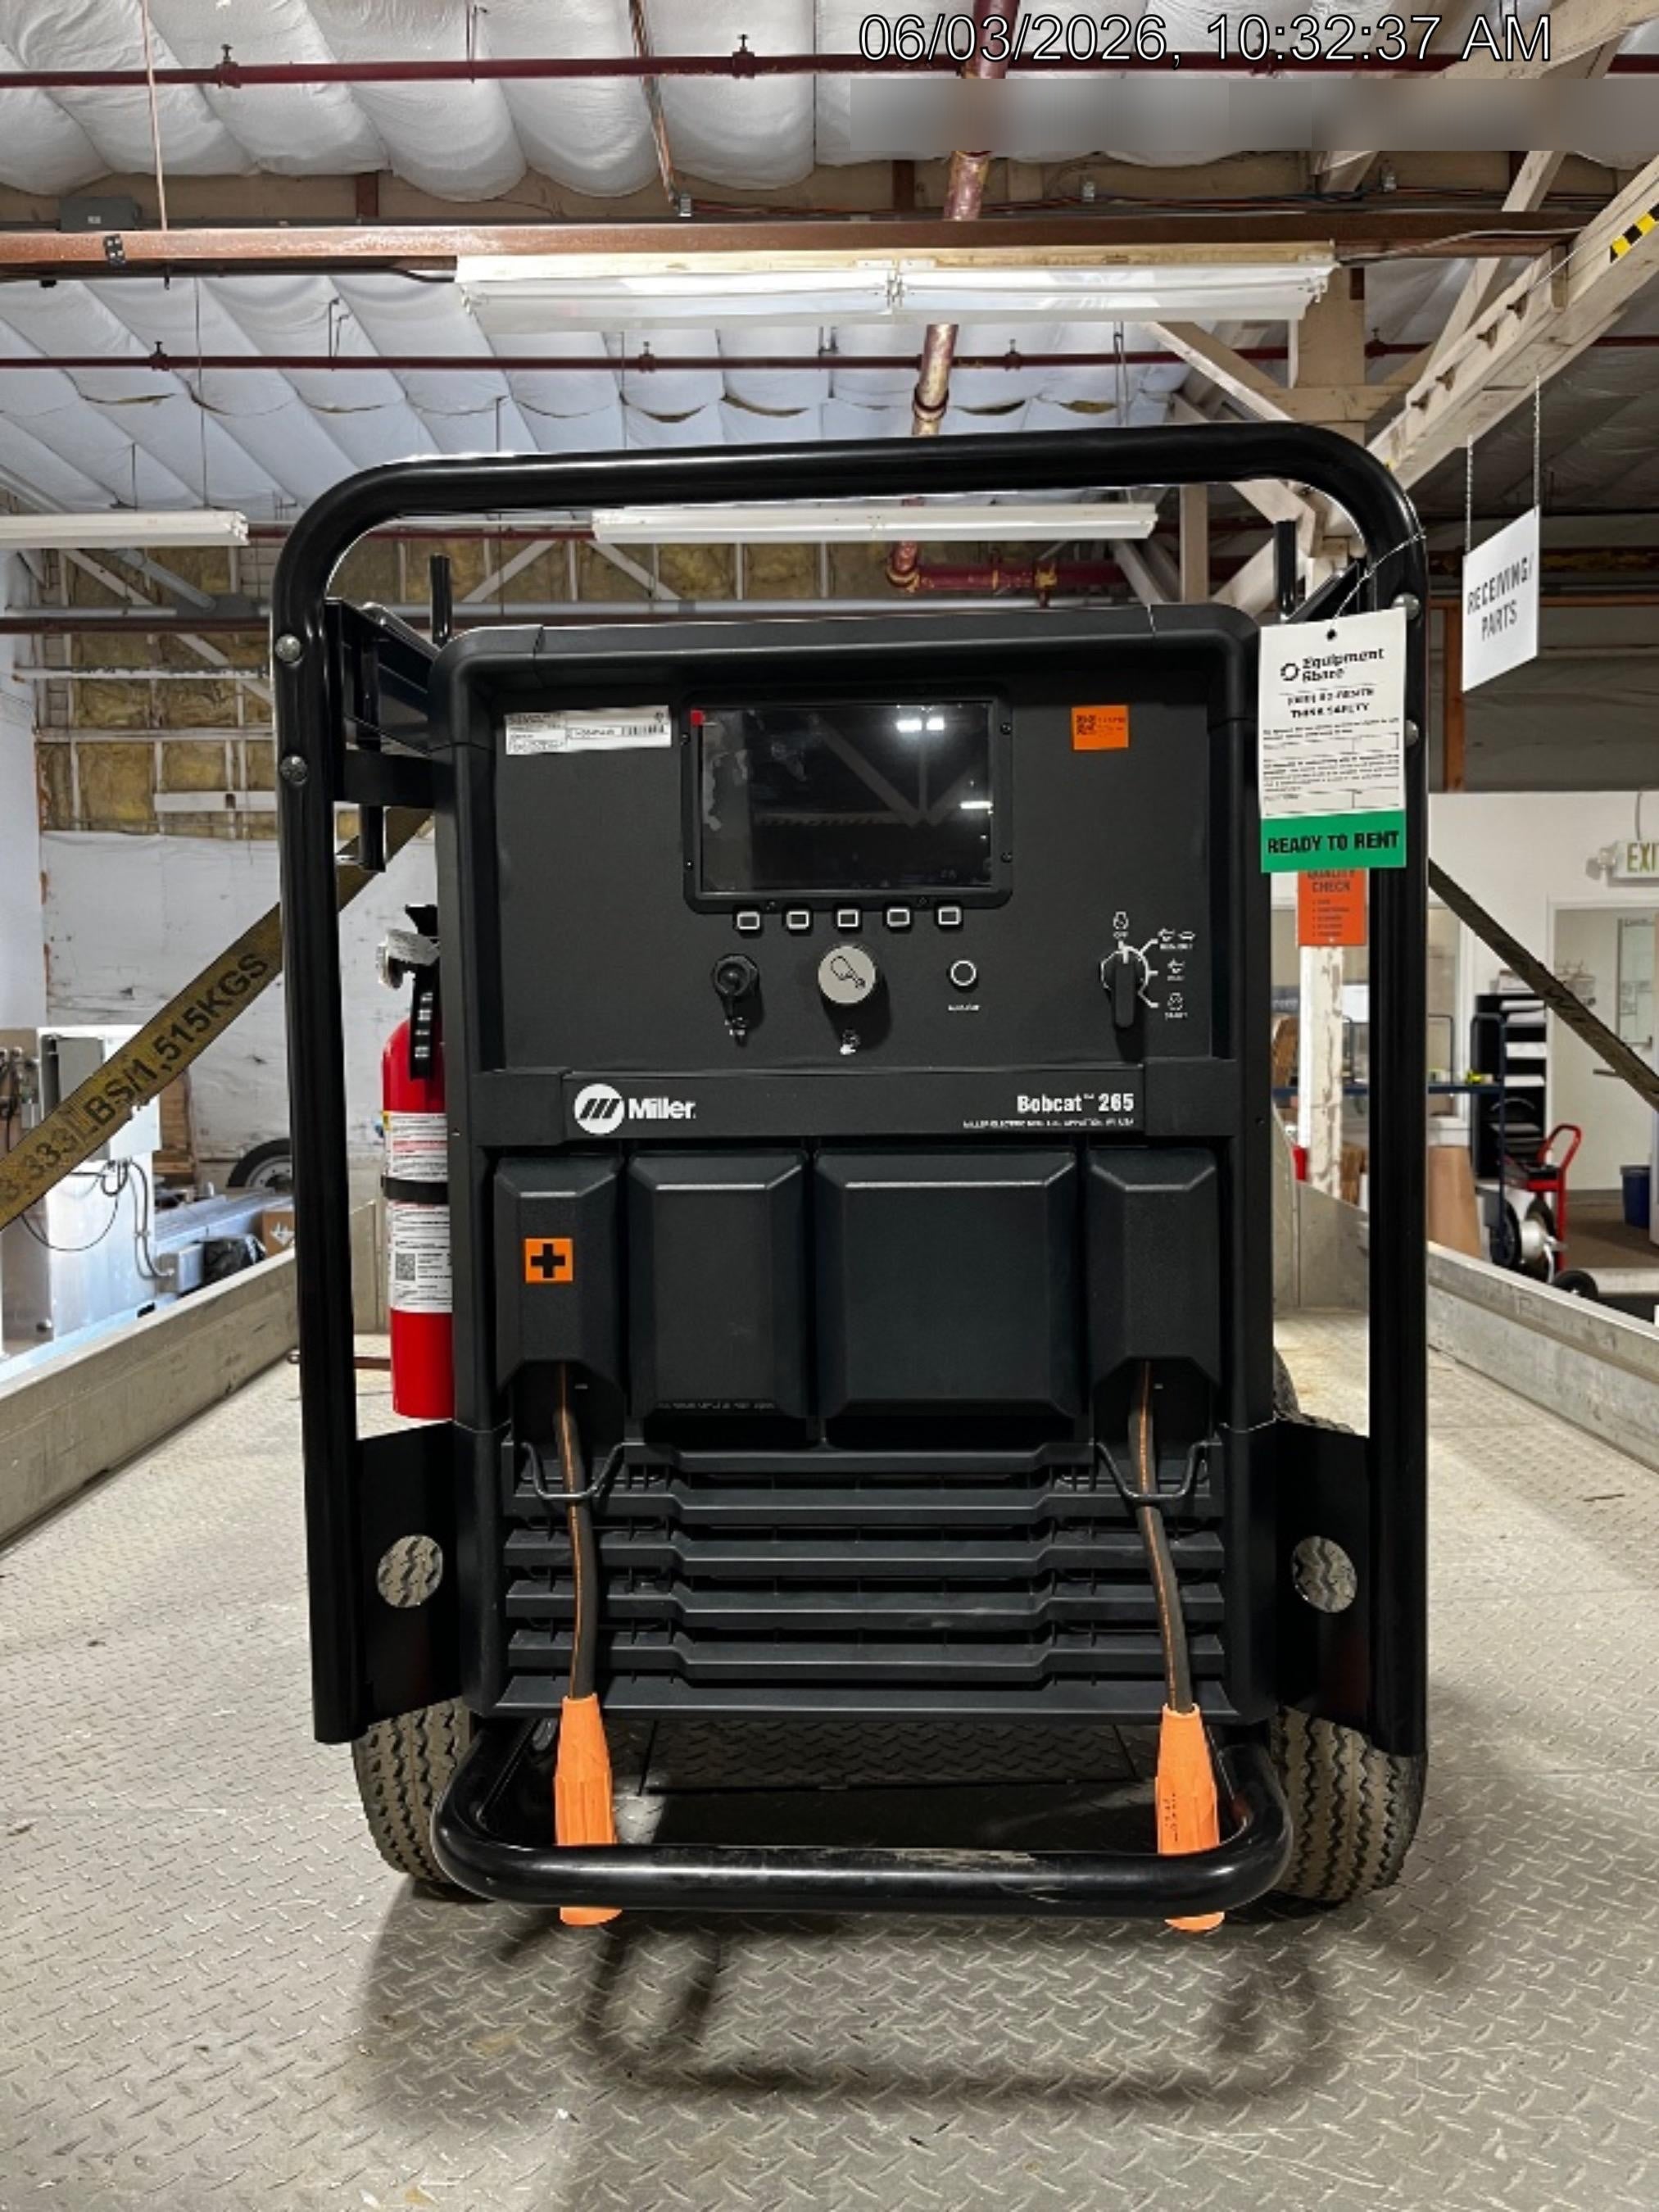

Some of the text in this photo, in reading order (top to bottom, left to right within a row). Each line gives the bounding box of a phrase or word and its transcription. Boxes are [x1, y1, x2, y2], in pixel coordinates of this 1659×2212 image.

[1481, 599, 1518, 641] PARTS
[1303, 648, 1385, 670] Equipment
[1267, 830, 1400, 854] READY TO RENT
[1626, 842, 1659, 873] EXI
[1312, 880, 1351, 893] CHECK
[628, 1097, 696, 1119] Miller
[1098, 1092, 1135, 1113] 265
